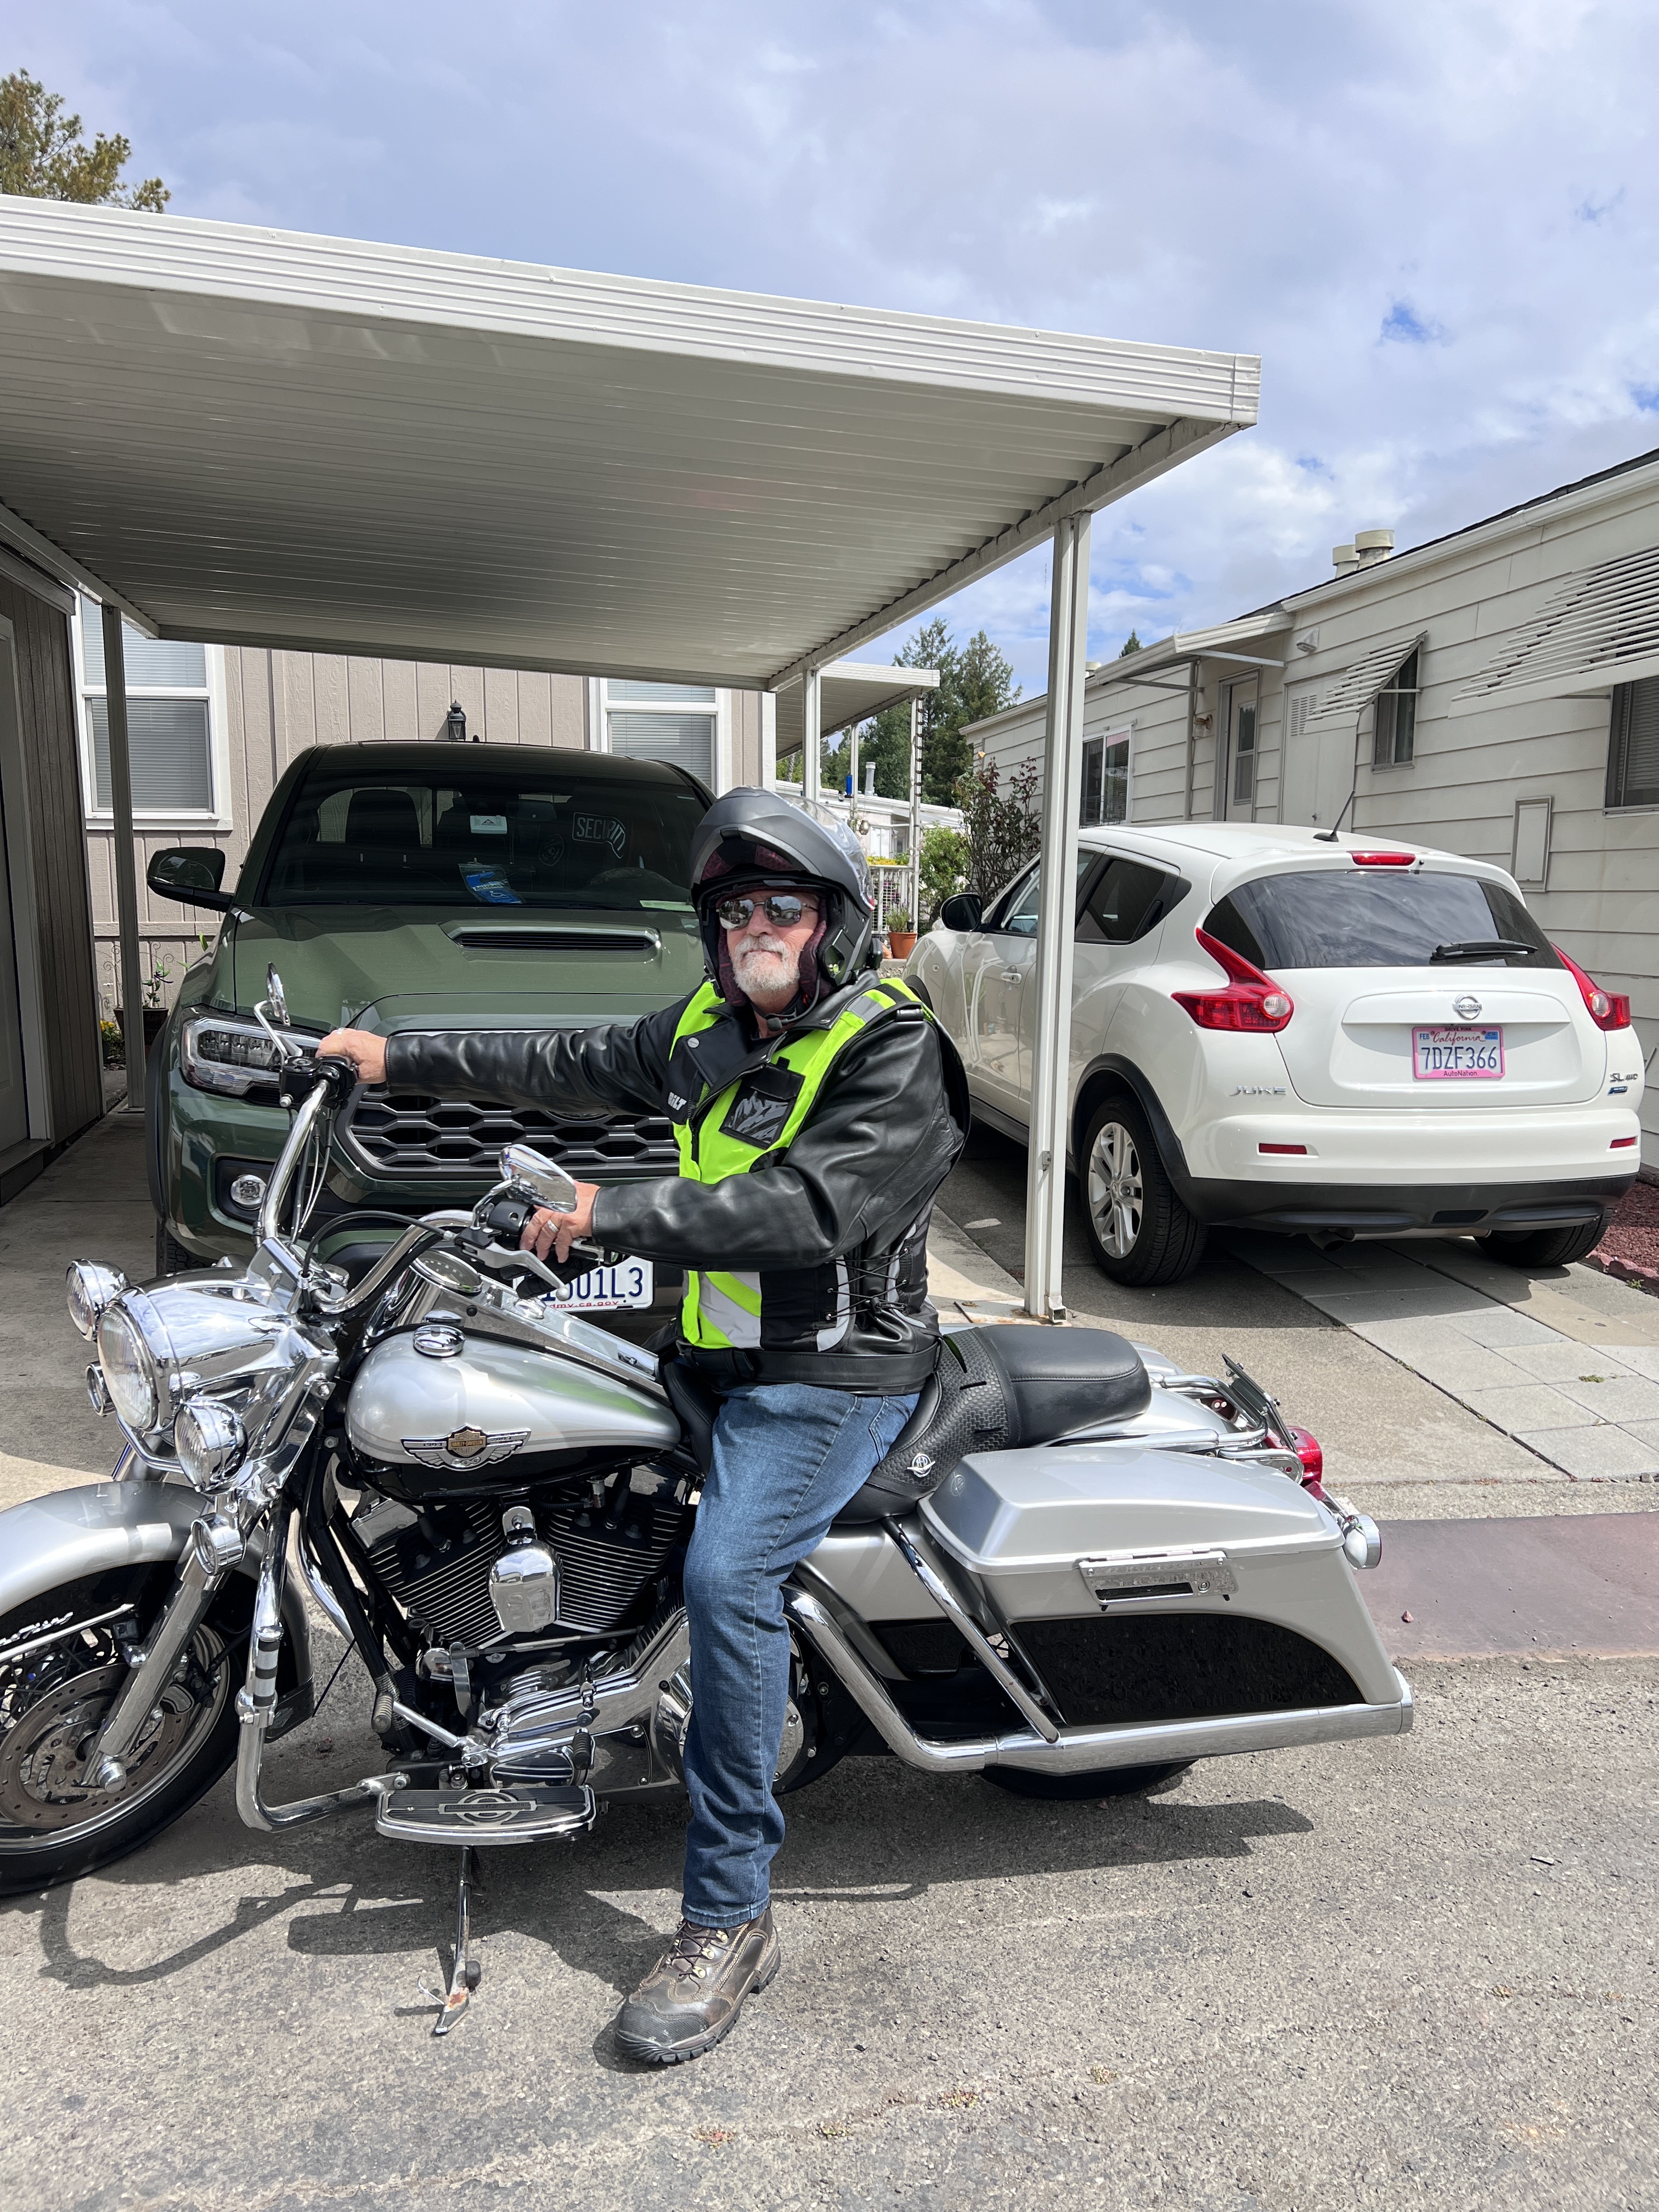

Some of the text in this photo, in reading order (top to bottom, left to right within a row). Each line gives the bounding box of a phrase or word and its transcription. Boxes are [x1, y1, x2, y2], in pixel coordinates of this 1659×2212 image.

[1433, 1031, 1486, 1046] California
[1421, 1046, 1497, 1070] 7DZF366
[1229, 1086, 1286, 1096] JUKE
